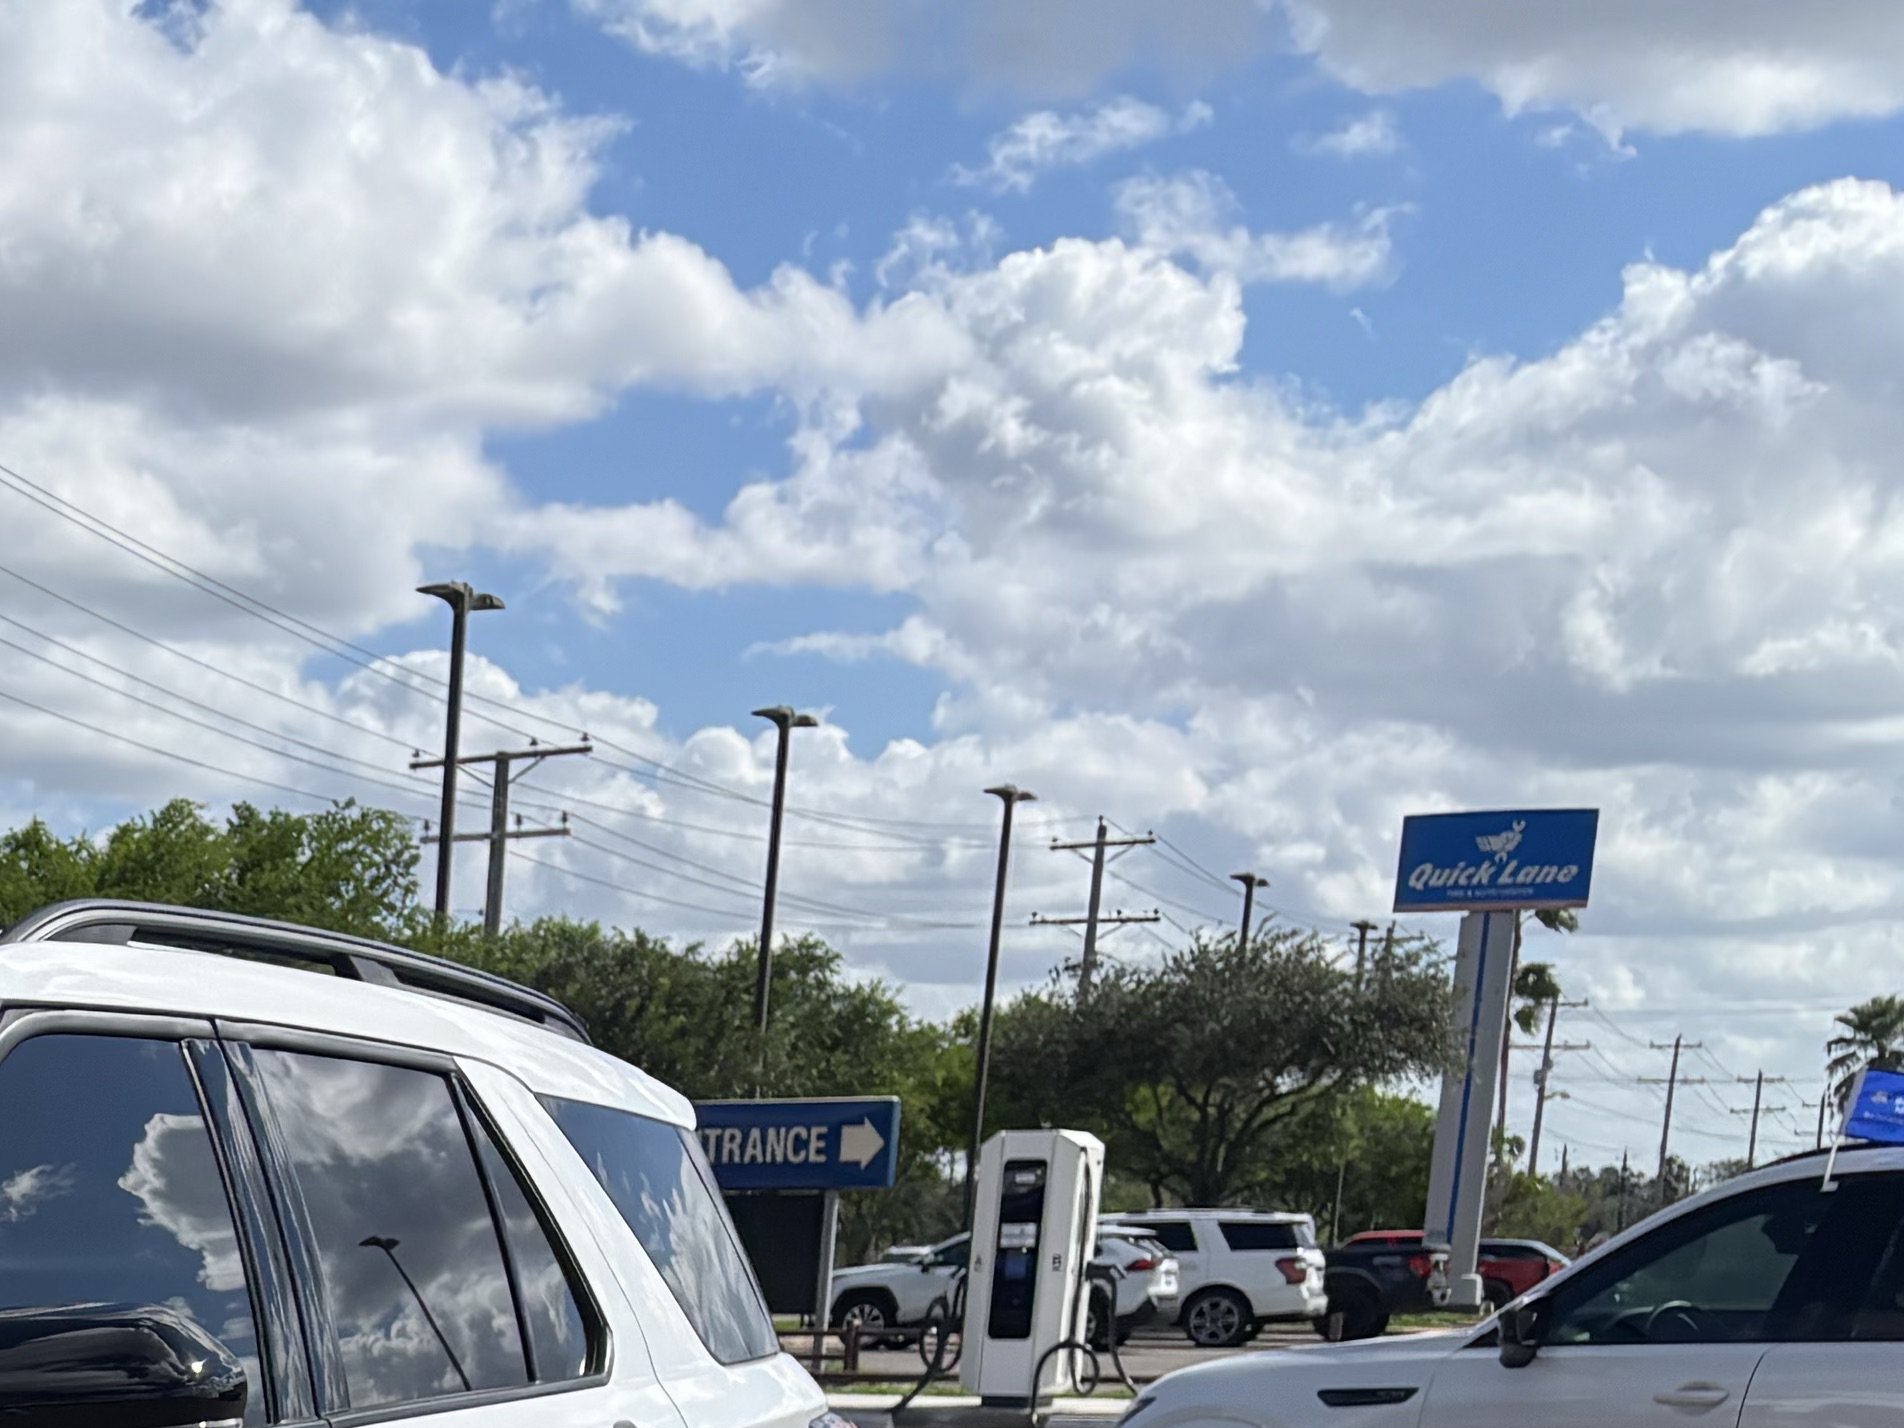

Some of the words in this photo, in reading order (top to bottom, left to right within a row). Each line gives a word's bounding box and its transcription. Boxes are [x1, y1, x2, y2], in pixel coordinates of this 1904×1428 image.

[1408, 860, 1496, 891] Quick
[1497, 859, 1579, 885] Lane
[698, 1125, 828, 1165] TRANCE
